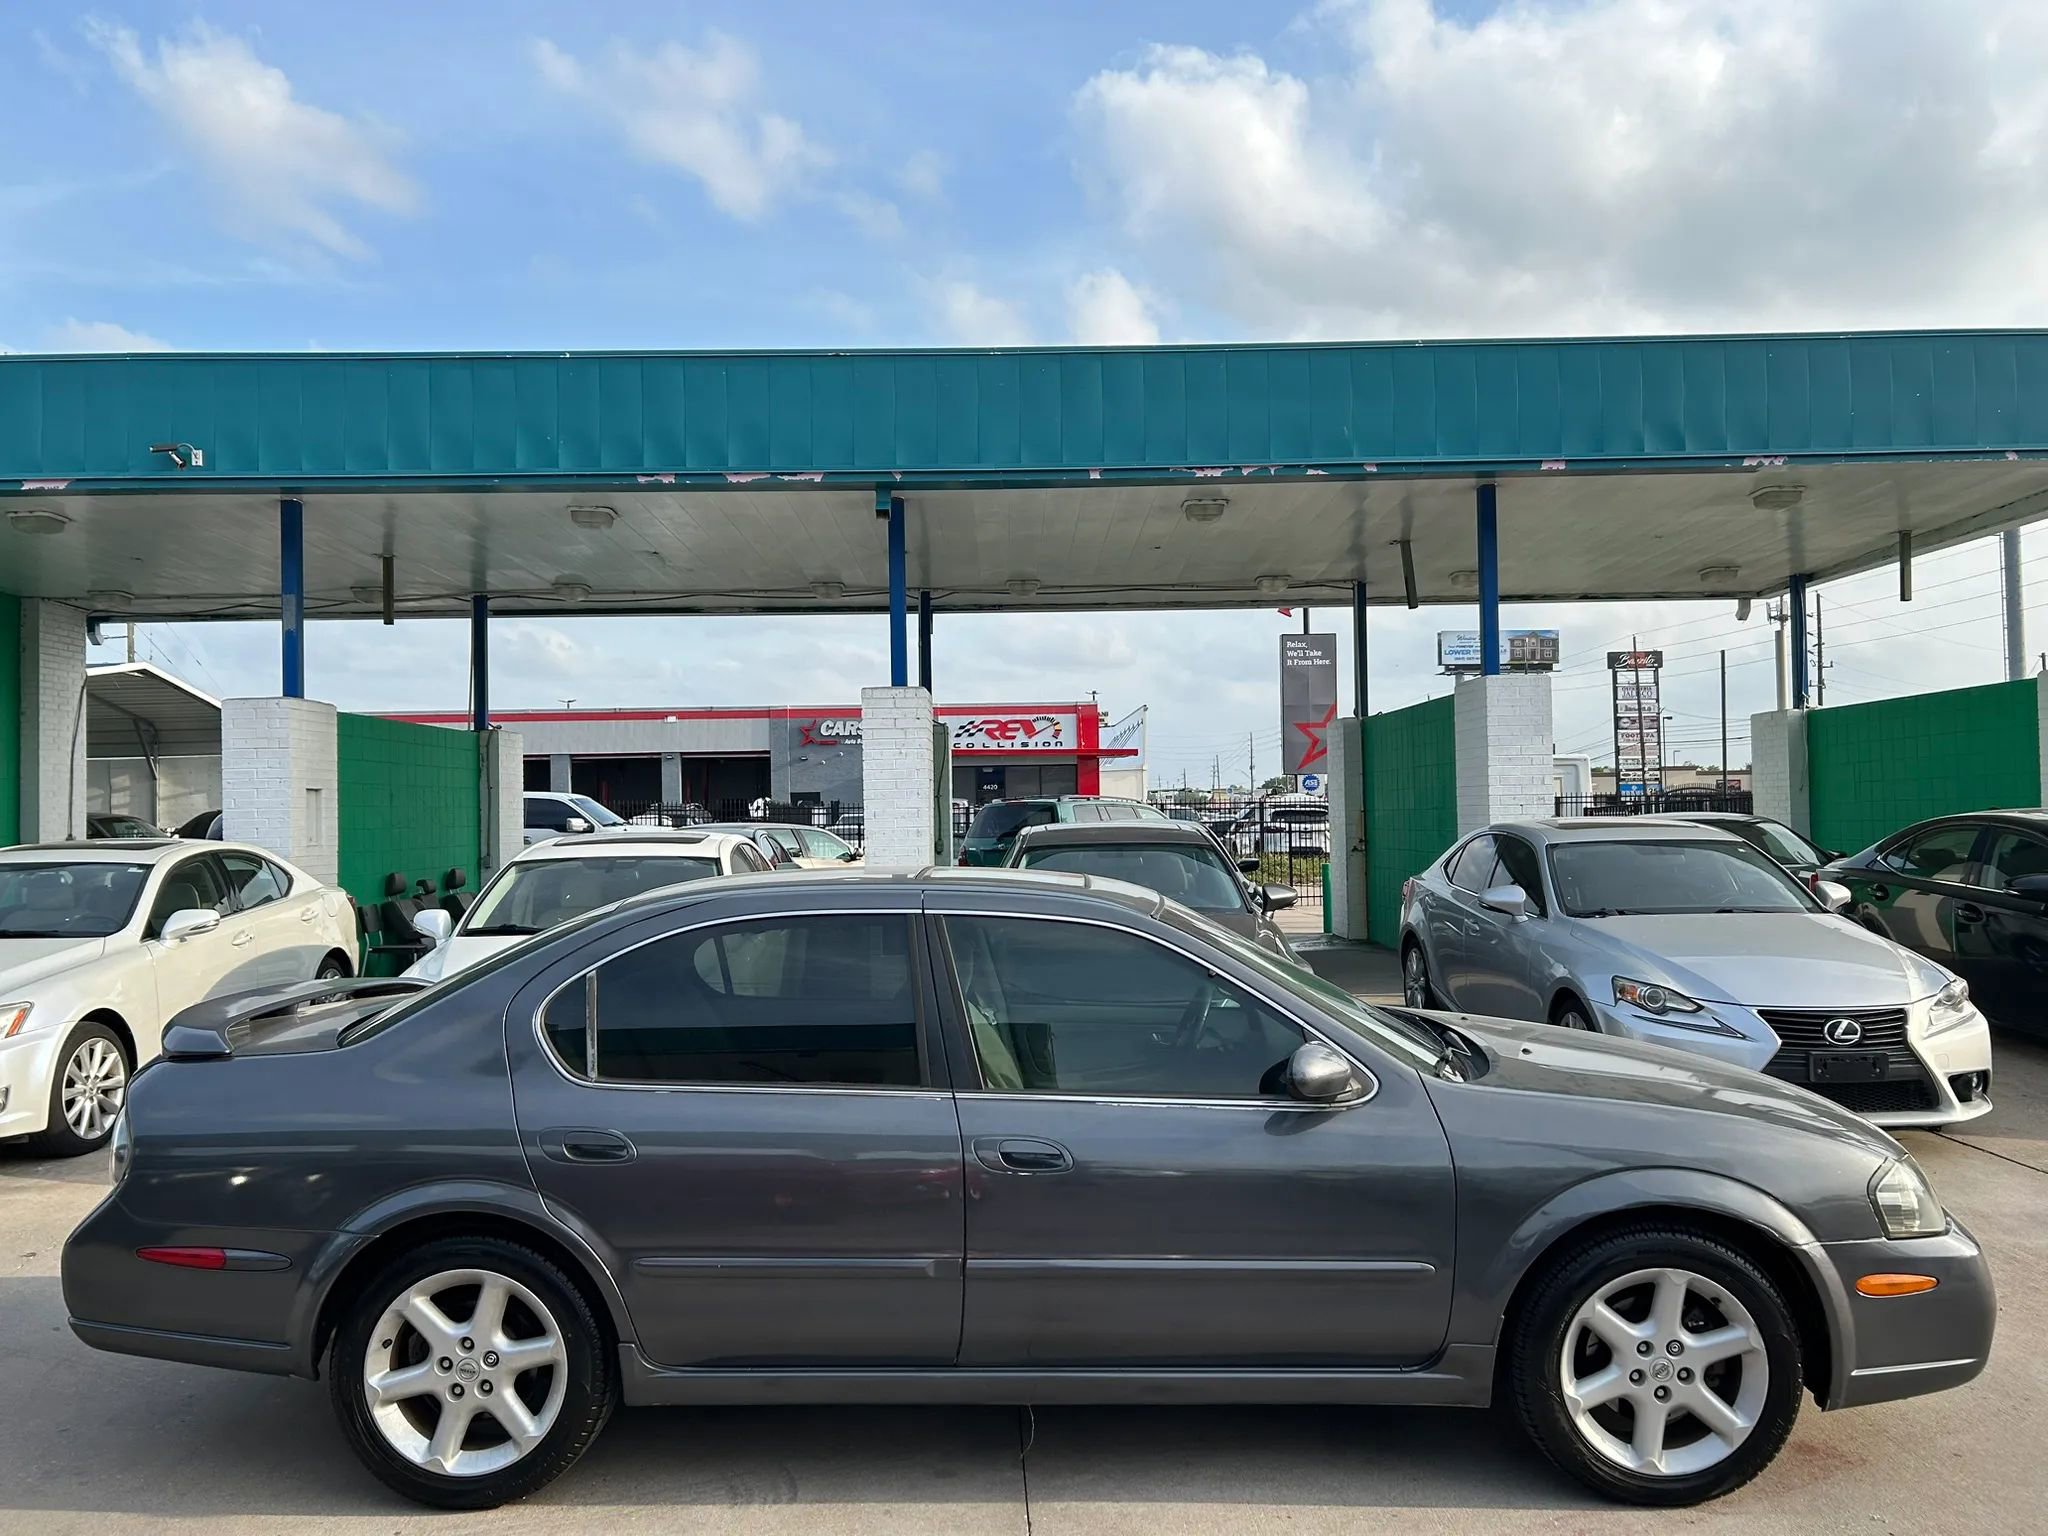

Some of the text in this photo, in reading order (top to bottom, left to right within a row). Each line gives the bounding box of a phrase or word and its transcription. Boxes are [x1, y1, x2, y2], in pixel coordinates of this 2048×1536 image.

[1286, 640, 1308, 649] Relax,
[1286, 649, 1322, 657] We'll Take
[1293, 658, 1312, 666] From
[973, 719, 1053, 740] REV
[953, 740, 1064, 749] COLLISION
